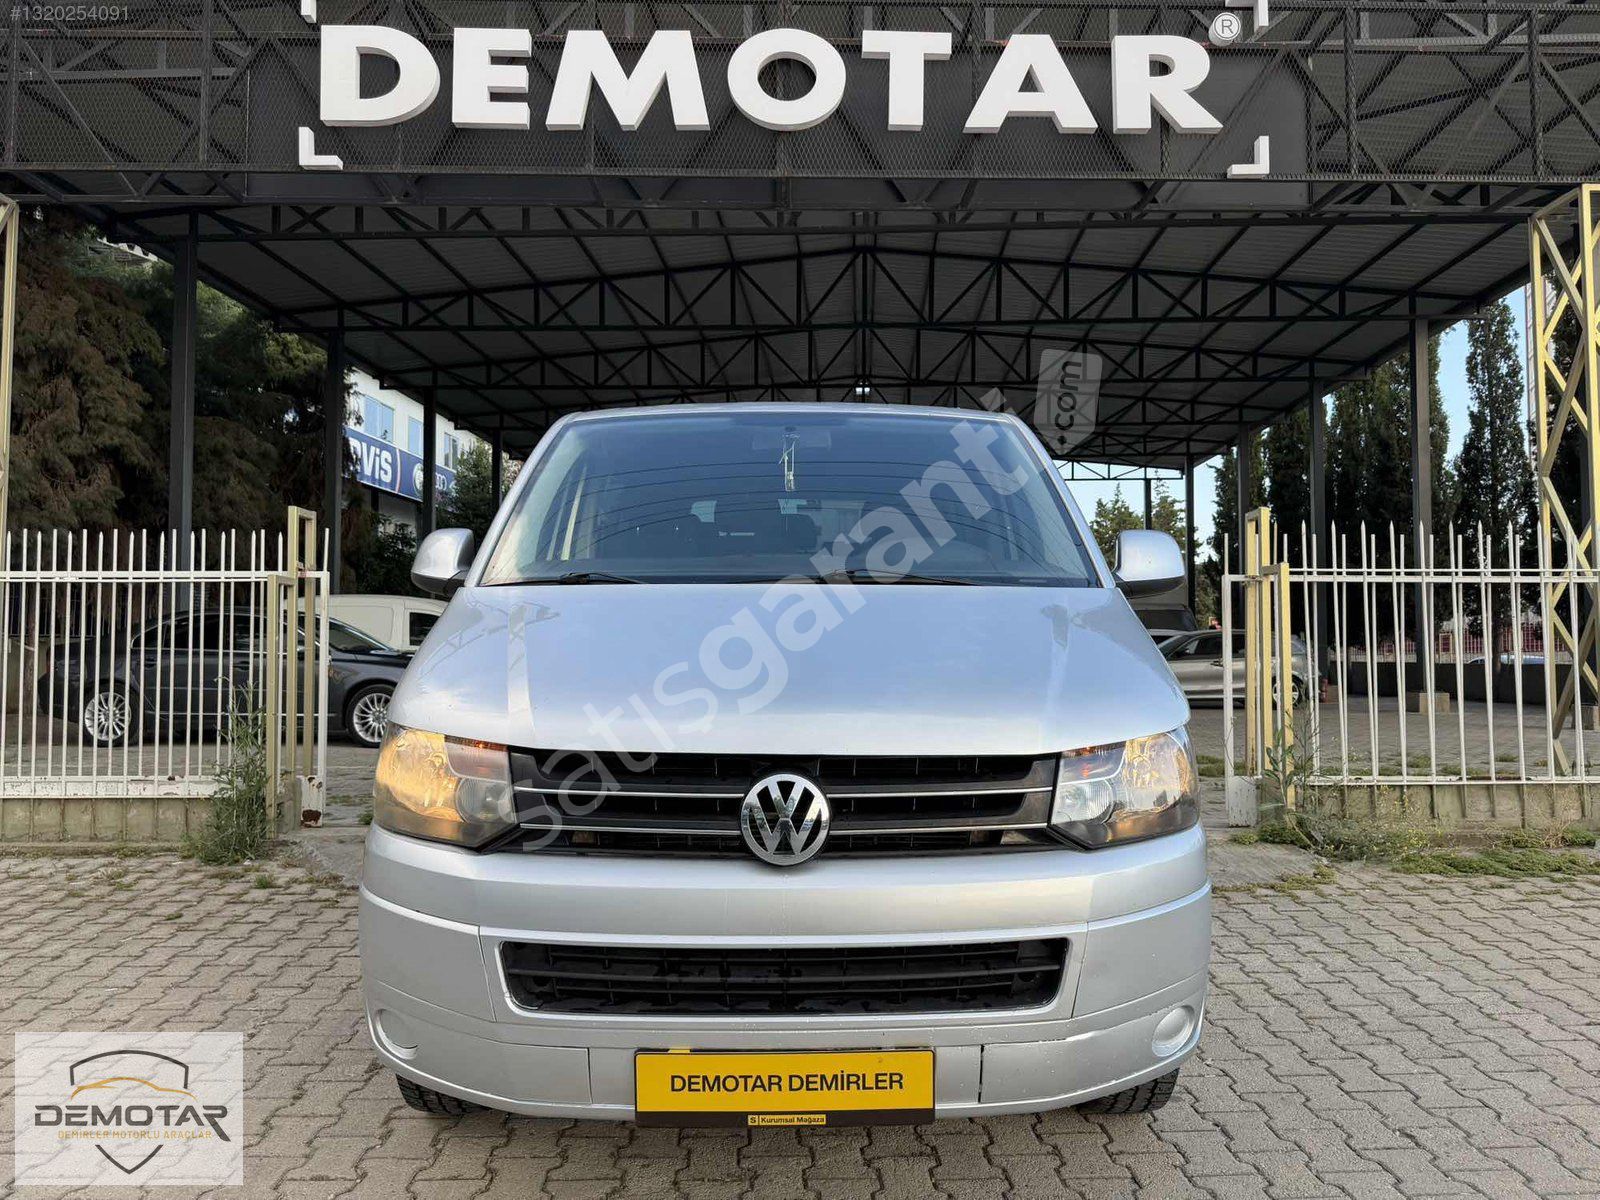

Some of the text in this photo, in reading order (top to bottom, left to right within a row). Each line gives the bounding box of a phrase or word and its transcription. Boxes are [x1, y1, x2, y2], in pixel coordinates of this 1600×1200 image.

[319, 23, 1224, 136] DEMOTAR
[670, 1069, 904, 1093] DEMOTAR DEMİRLER
